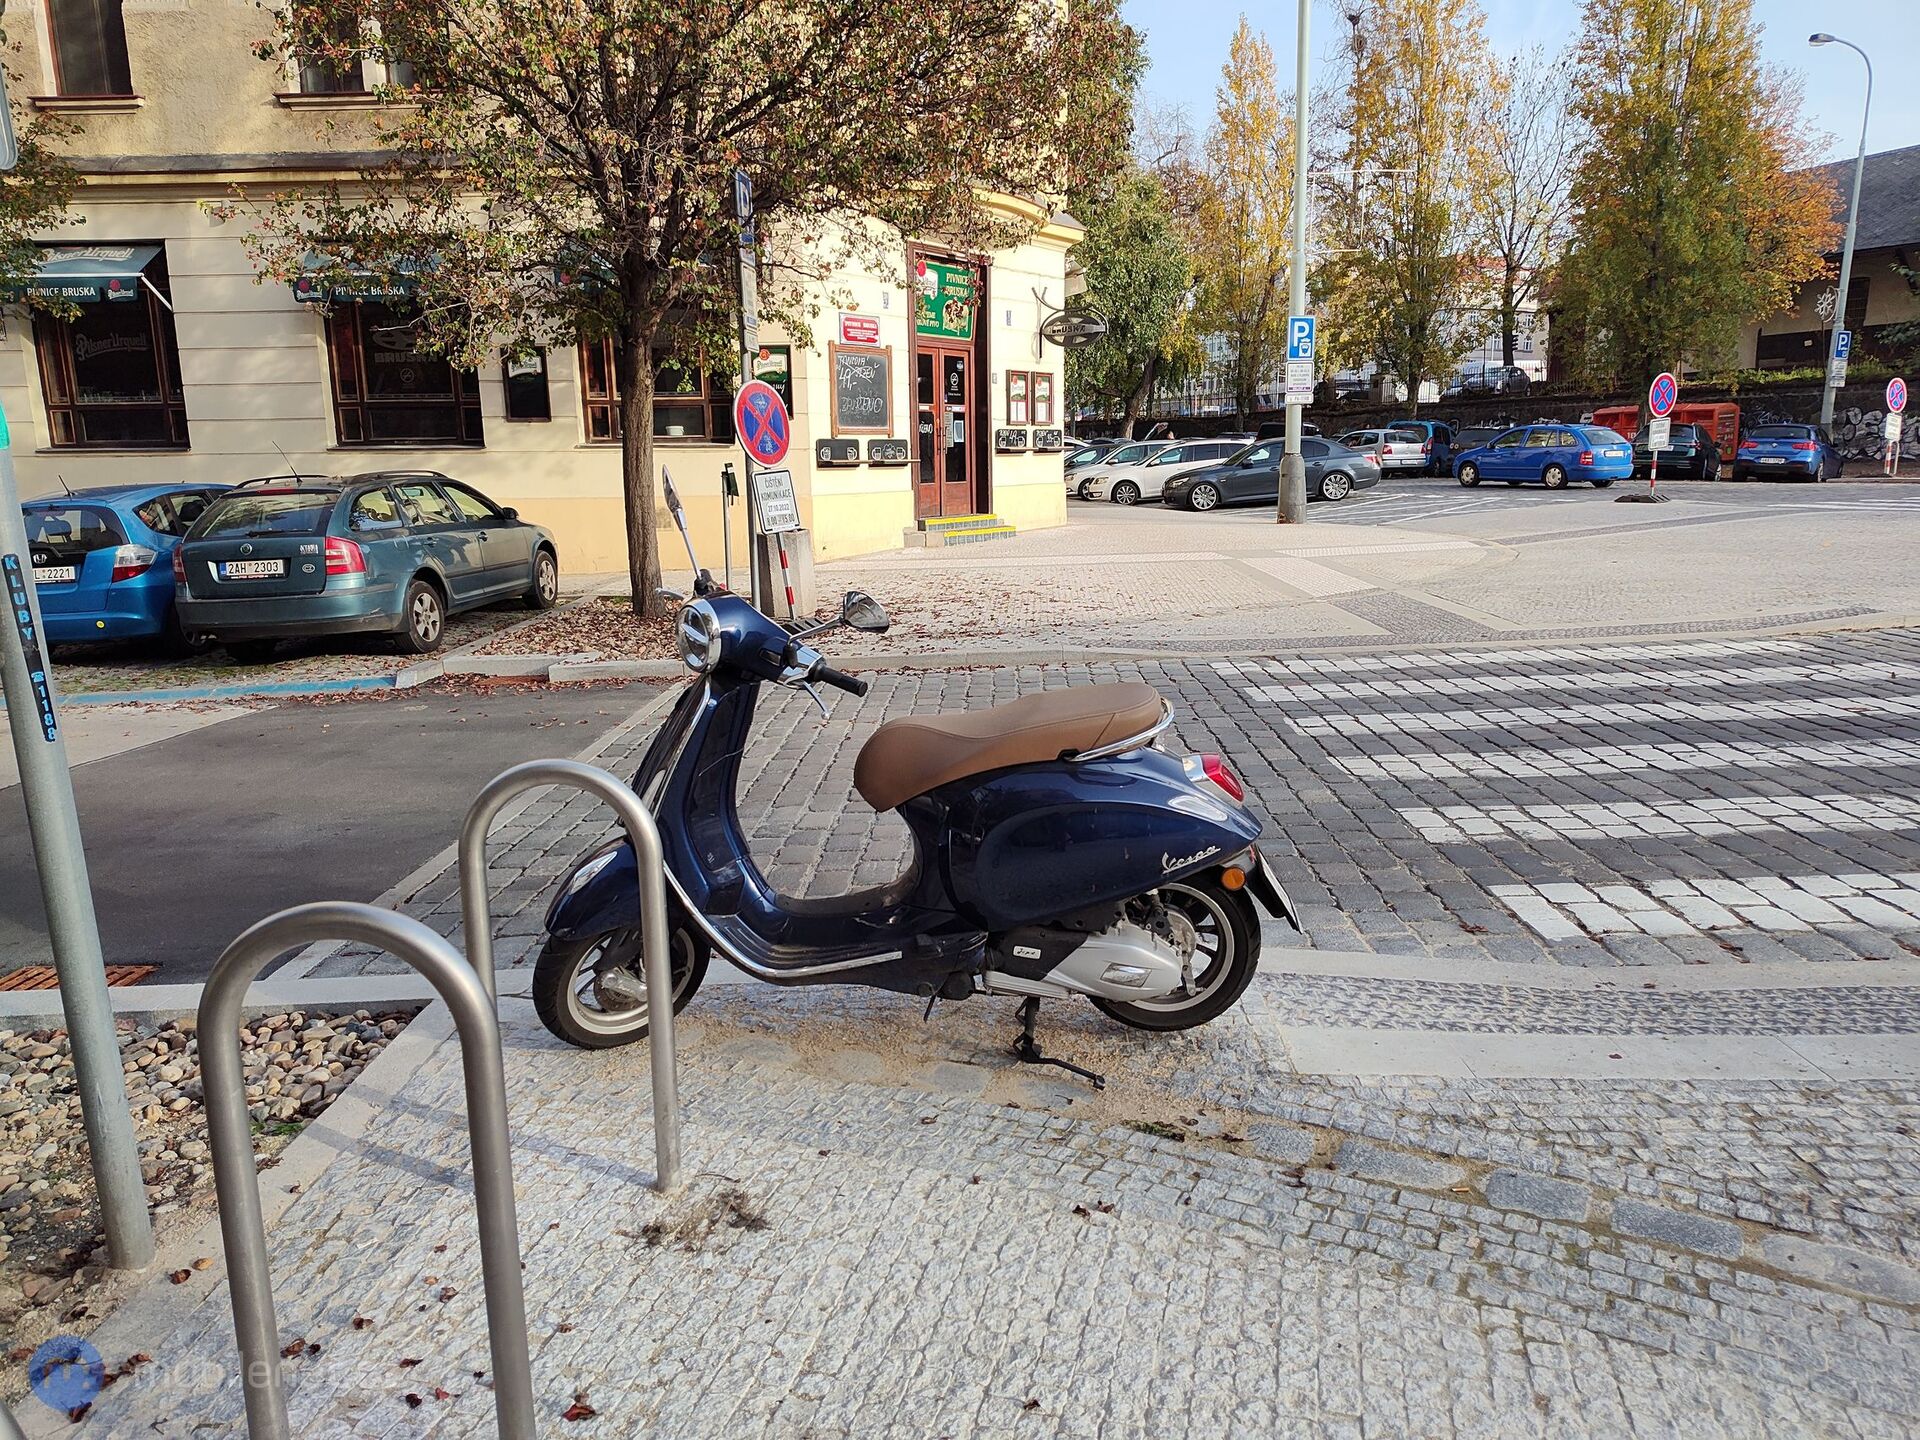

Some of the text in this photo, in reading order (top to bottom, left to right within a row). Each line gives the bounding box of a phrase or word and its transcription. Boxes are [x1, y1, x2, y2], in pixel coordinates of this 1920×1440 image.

[62, 287, 96, 296] BRUSKA
[1294, 321, 1310, 347] P
[47, 568, 71, 579] 2221
[228, 562, 279, 575] 2AH 2303
[1161, 845, 1221, 875] Vespa
